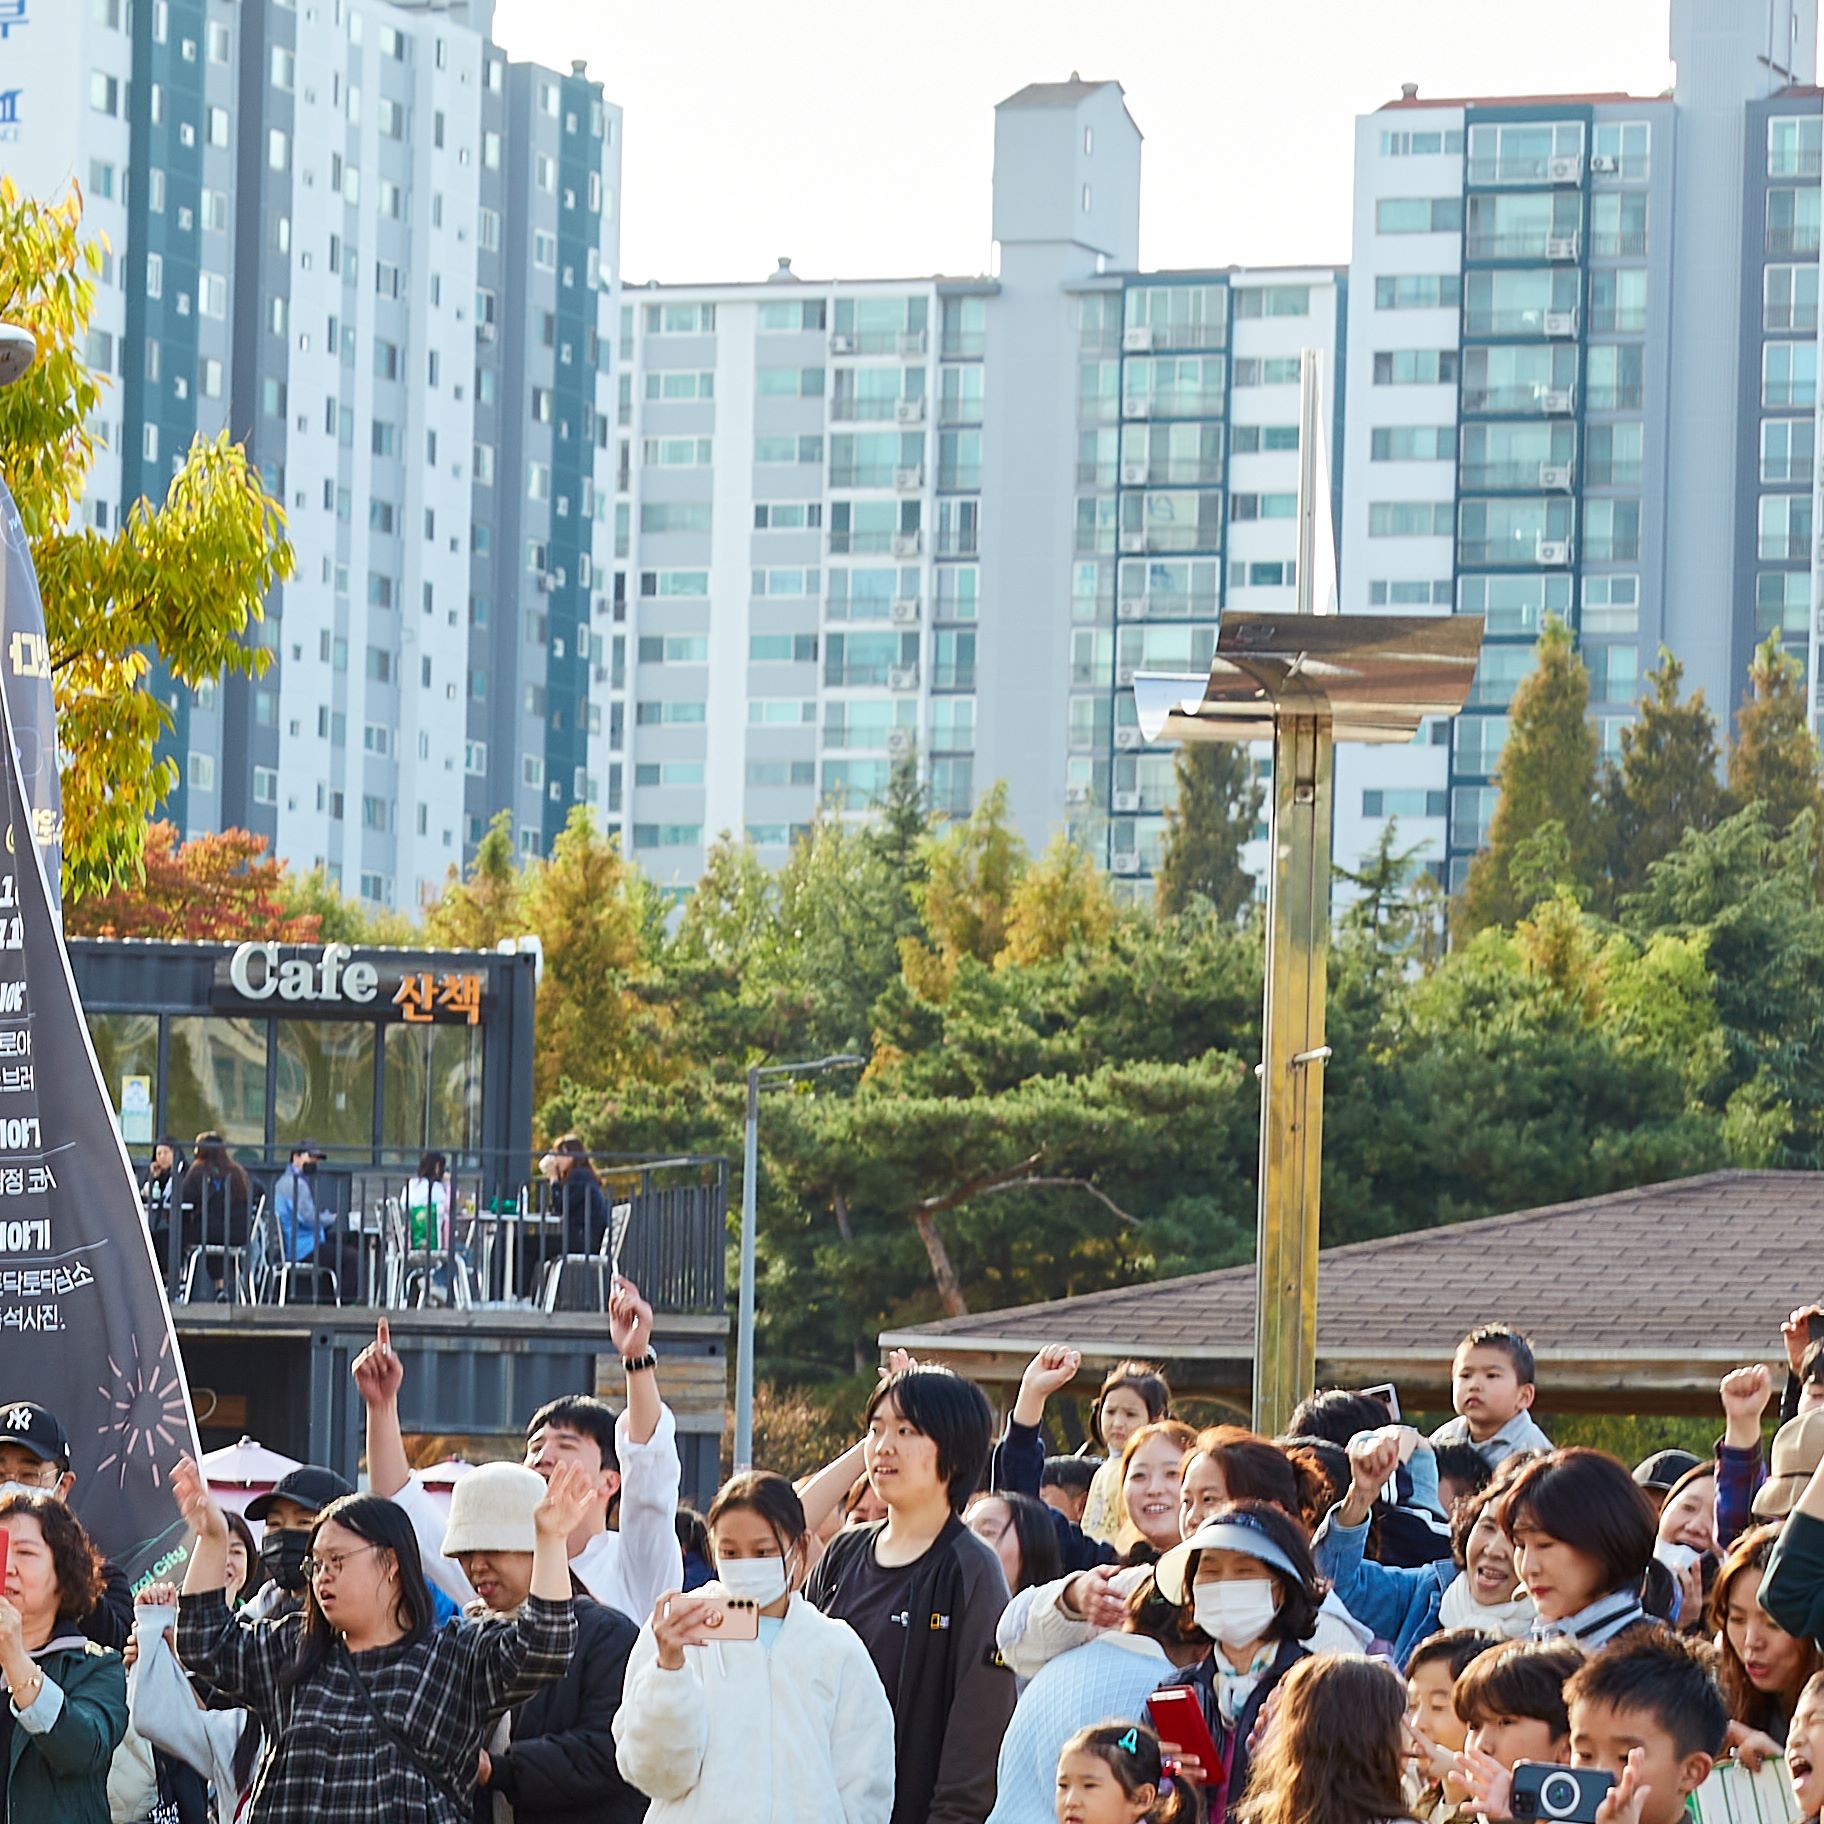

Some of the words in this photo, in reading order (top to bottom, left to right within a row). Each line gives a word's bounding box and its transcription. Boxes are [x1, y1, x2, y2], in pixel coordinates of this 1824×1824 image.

[230, 941, 378, 1003] Cafe
[392, 971, 481, 1025] 산책
[6, 1407, 32, 1431] NY
[153, 1545, 188, 1577] City
